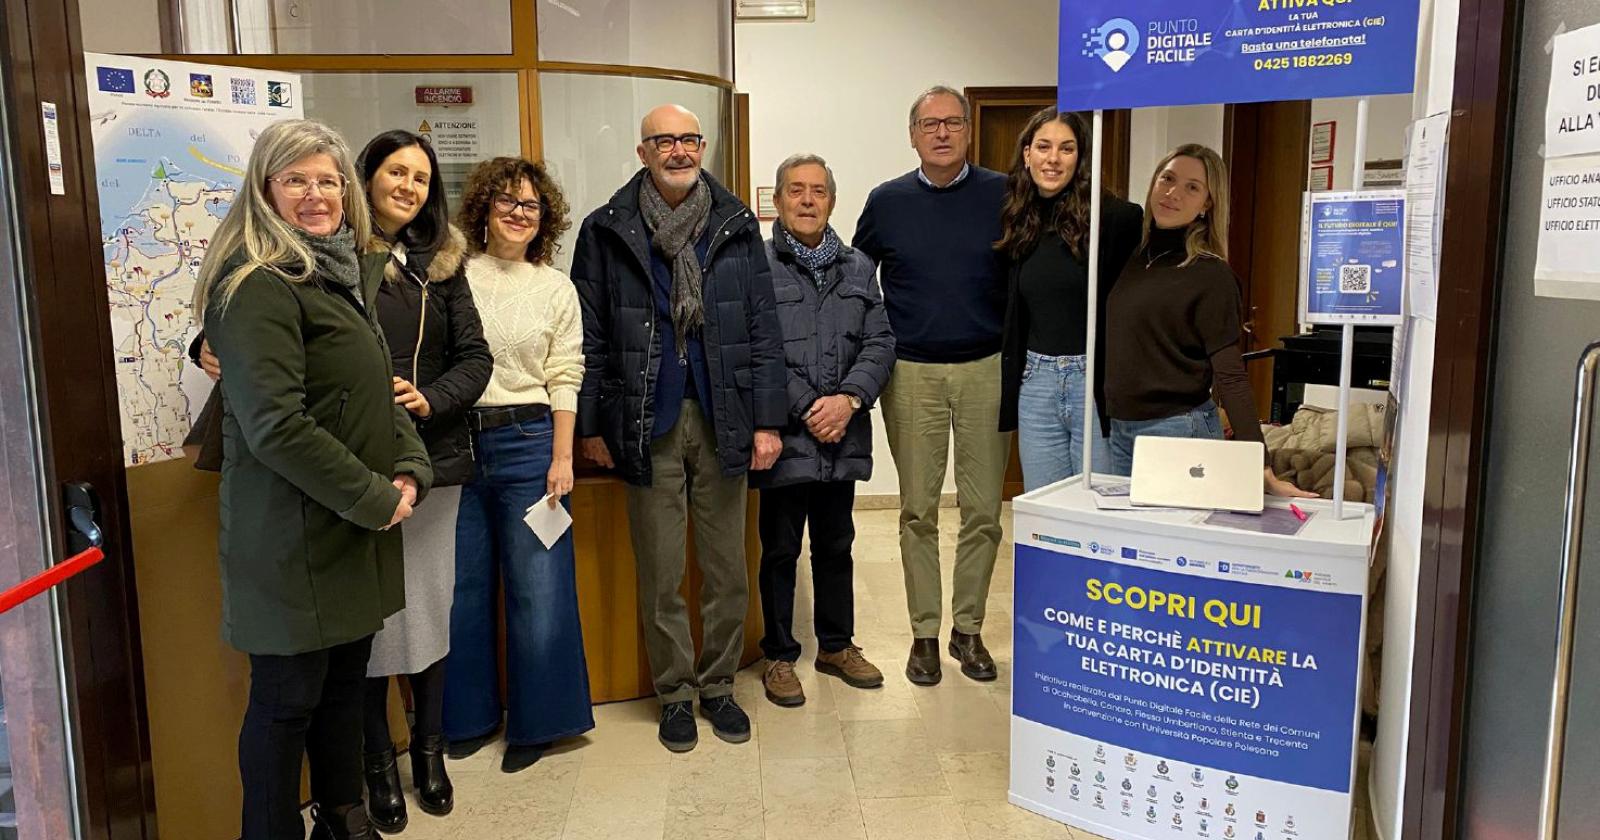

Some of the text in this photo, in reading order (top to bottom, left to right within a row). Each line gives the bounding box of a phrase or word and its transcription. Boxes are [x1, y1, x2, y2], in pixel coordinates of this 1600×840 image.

[1288, 12, 1319, 21] LA TUA
[1148, 19, 1198, 35] PUNTO
[1225, 16, 1385, 37] CARTA D'IDENTITÀ ELETTRONICA (CIE)
[1147, 32, 1212, 49] DIGITALE
[1241, 34, 1366, 53] Basta una telefonata!
[1147, 48, 1196, 64] FACILE
[1254, 52, 1352, 70] 0425 1882269
[1573, 56, 1600, 77] SI E
[423, 95, 462, 103] INCENDIO
[1559, 113, 1594, 134] ALLA
[128, 127, 162, 138] DELTA
[190, 133, 206, 143] del
[1550, 174, 1580, 186] UFFICIO
[1547, 197, 1577, 209] UFFICIO
[1545, 220, 1575, 231] UFFICIO
[1086, 578, 1261, 629] SCOPRI QUI
[1043, 607, 1318, 670] COME E PERCHÈ ATTIVARE LA
[1065, 631, 1284, 688] TUA CARTA D'IDENTITÀ
[1081, 656, 1260, 709] ELETTRONICA (CIE)
[1035, 672, 1320, 740] Iniziativa realizzata dal Punto Digitale Facile della Rete dei Comuni
[1072, 705, 1123, 724] convenzione
[1124, 719, 1141, 729] con
[1191, 734, 1233, 749] Popolare
[1235, 741, 1279, 757] Polesana
[1100, 701, 1133, 717] Canaro,
[1134, 709, 1161, 722] Fiesso
[1163, 717, 1219, 735] Umbertiano,
[1220, 727, 1254, 741] Stienta
[1265, 735, 1308, 750] Trecenta
